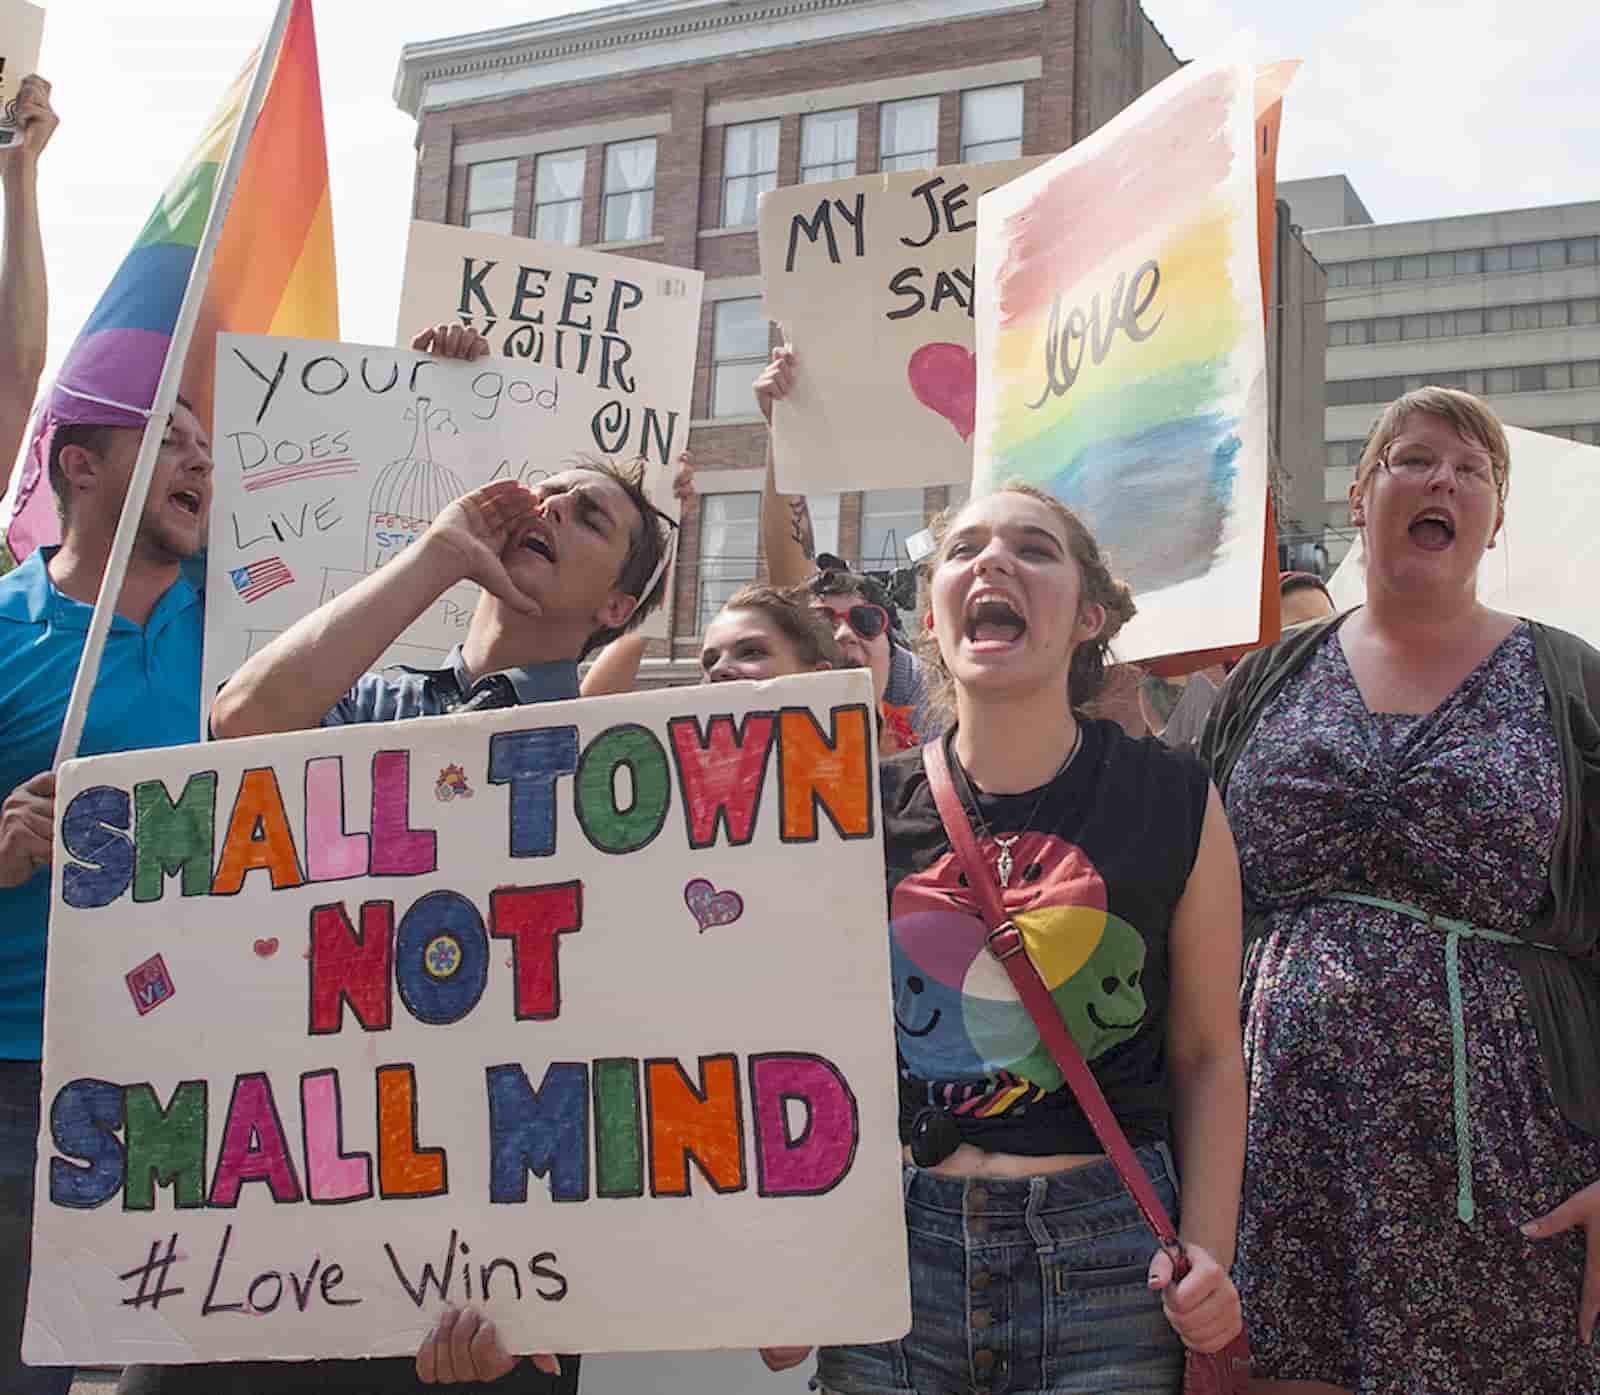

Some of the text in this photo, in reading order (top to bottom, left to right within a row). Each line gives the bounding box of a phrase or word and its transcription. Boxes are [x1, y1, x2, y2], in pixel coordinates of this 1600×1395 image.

[786, 176, 996, 272] MY JE
[457, 257, 643, 332] KEEP
[461, 316, 636, 393] OUR
[1024, 260, 1165, 409] love
[471, 371, 559, 419] god
[591, 400, 679, 465] ON
[225, 430, 352, 470] DOES
[62, 704, 874, 908] SMALL TOWN
[309, 881, 584, 1035] NOT
[49, 1052, 858, 1210] SMALL MIND
[384, 1229, 568, 1306] Wins
